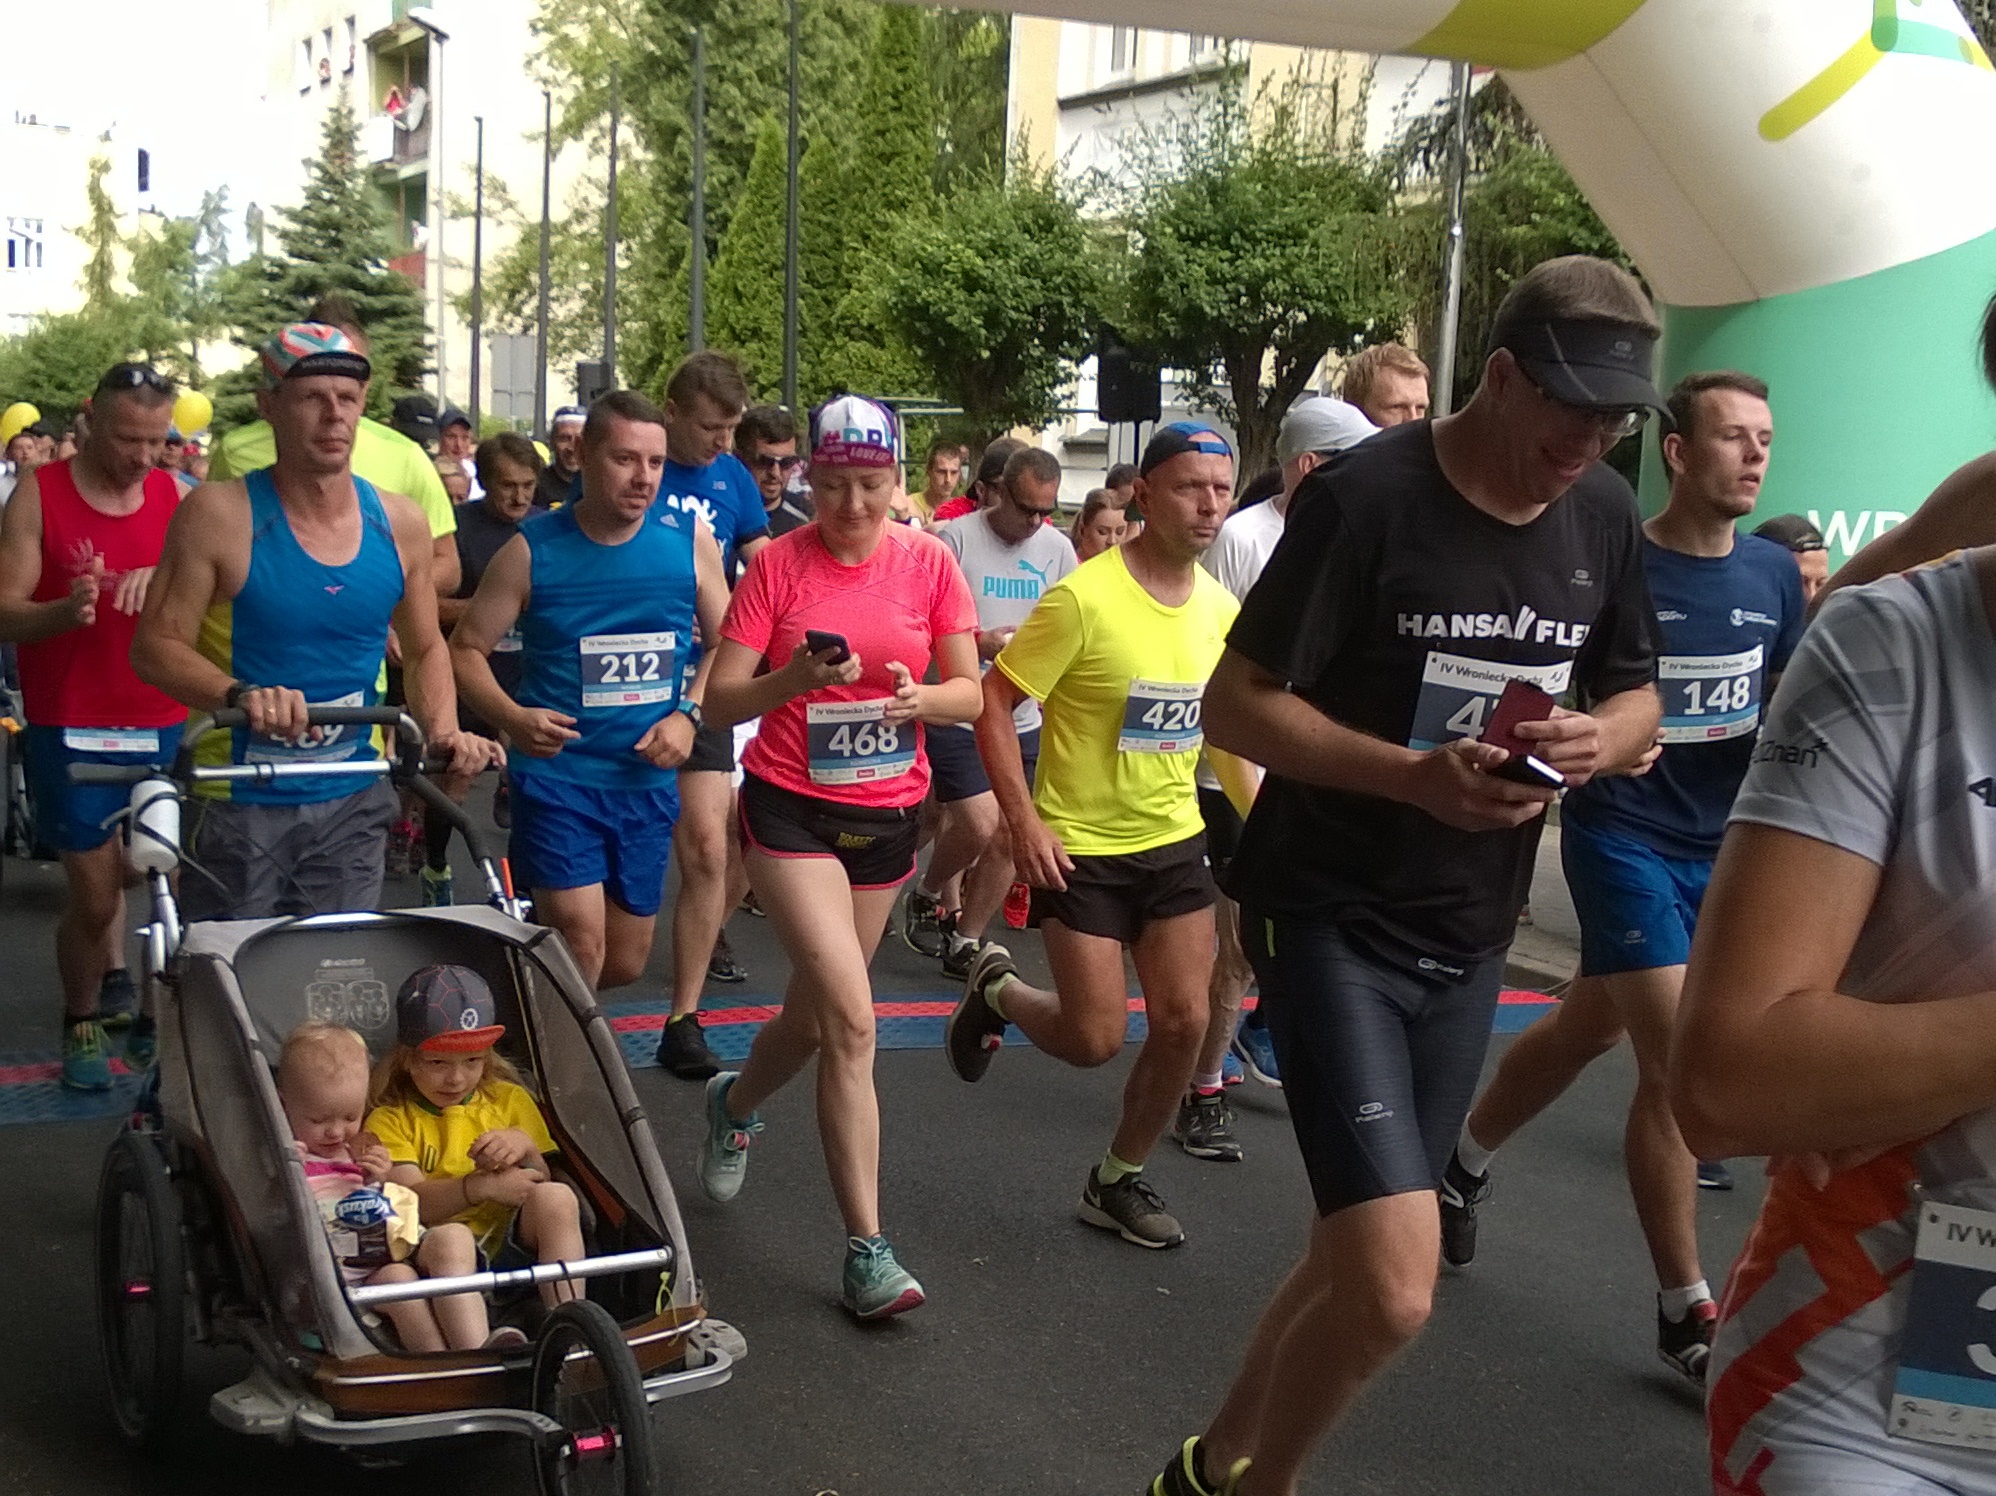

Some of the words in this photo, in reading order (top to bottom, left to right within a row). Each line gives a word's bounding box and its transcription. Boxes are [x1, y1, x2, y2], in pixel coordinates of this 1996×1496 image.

[983, 576, 1039, 600] PUMA
[1398, 613, 1514, 639] HANSA
[600, 652, 660, 683] 212
[1440, 662, 1454, 674] IV
[1682, 675, 1750, 715] 148
[1141, 700, 1201, 731] 420
[828, 722, 900, 758] 468
[1948, 1223, 1971, 1243] IV
